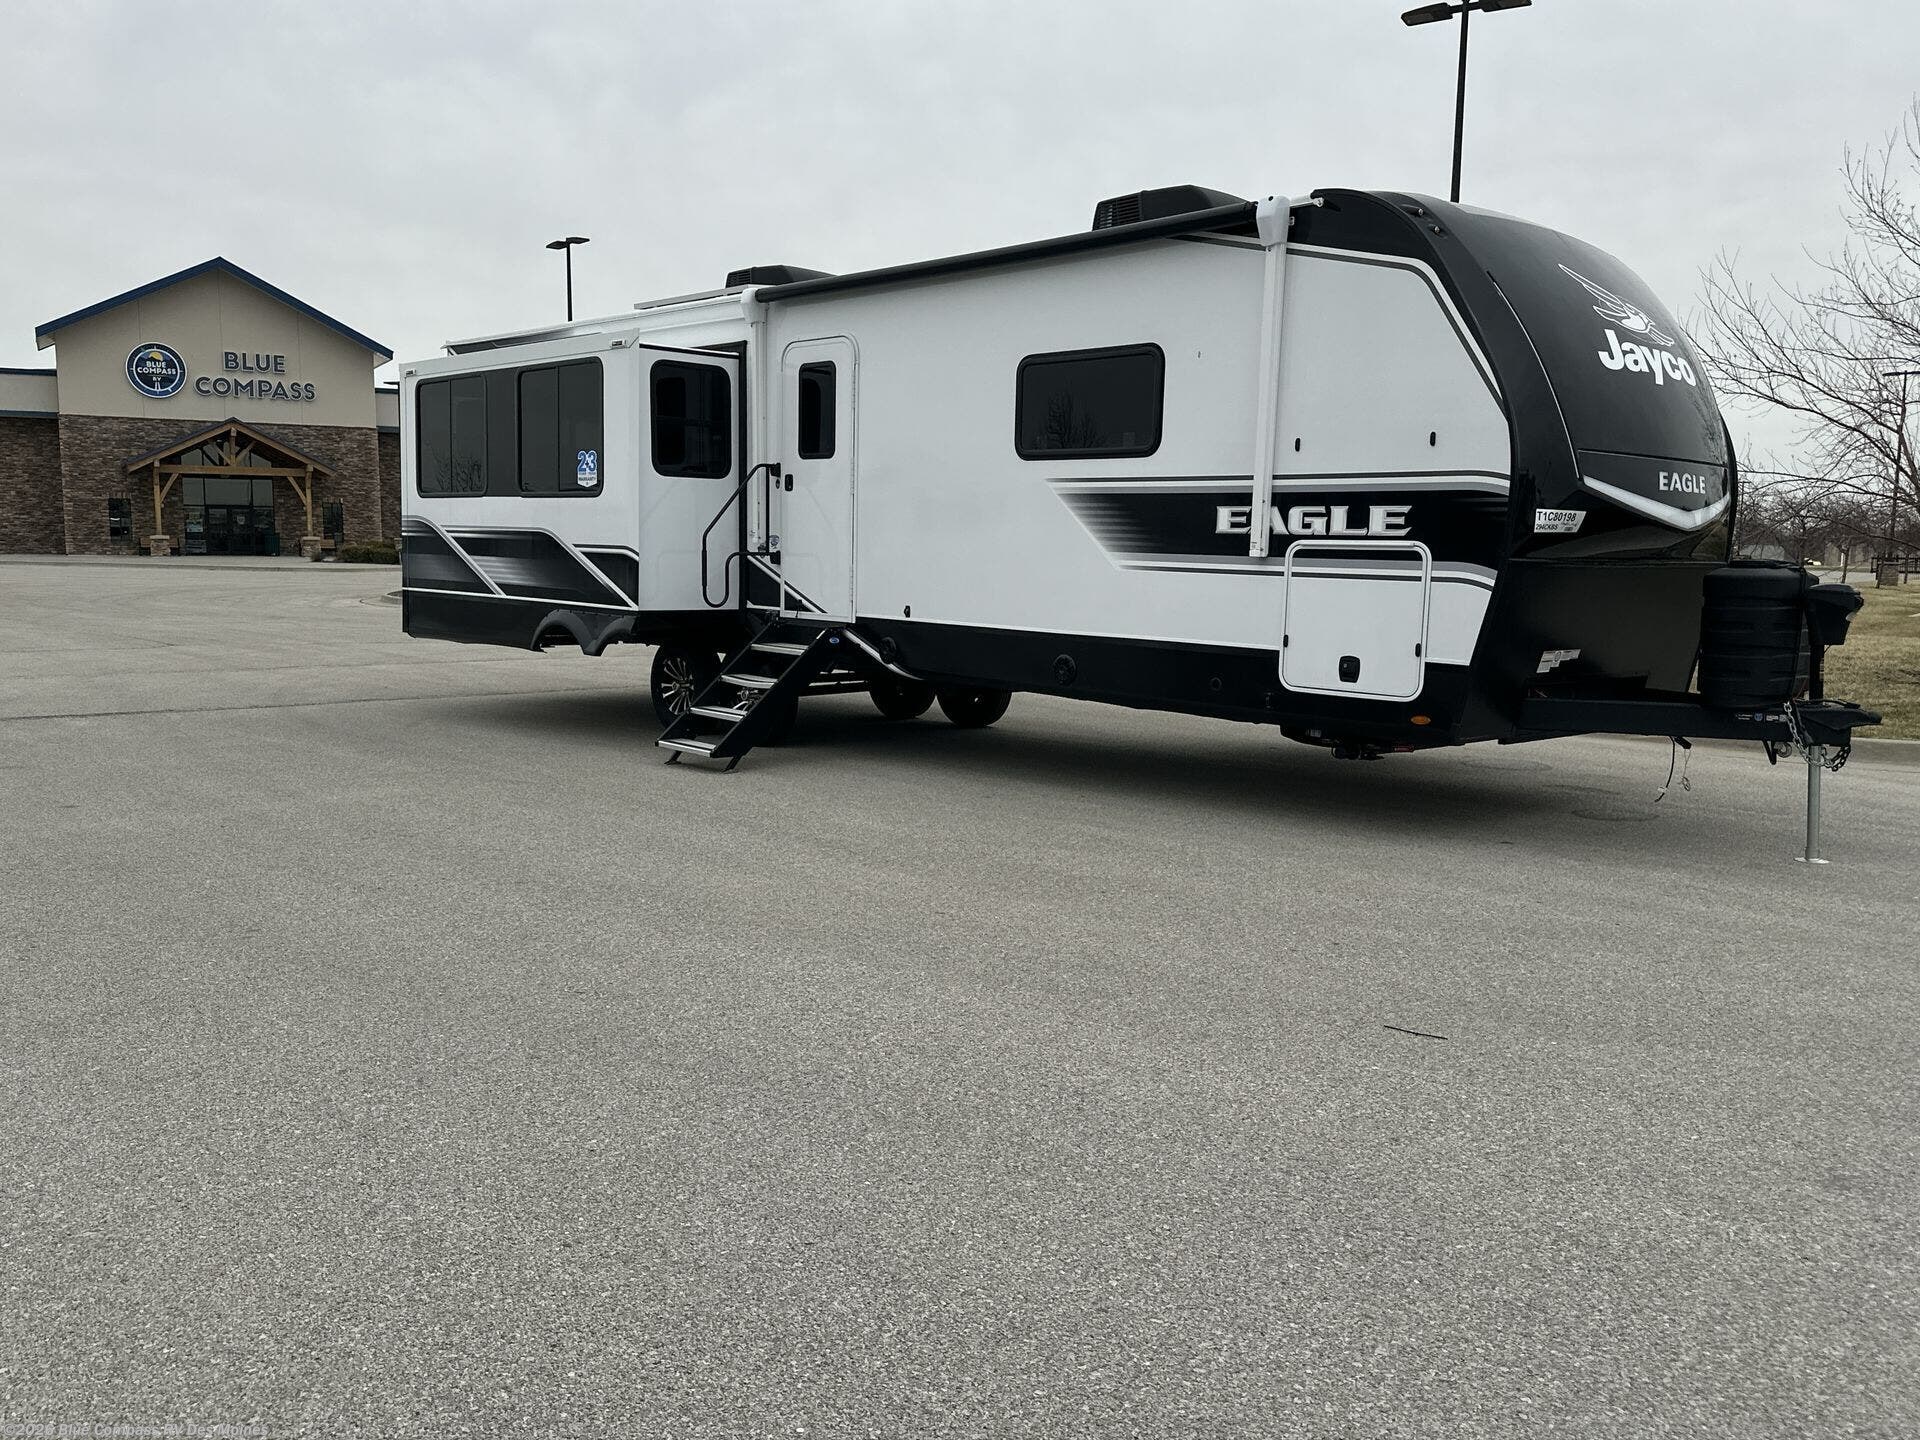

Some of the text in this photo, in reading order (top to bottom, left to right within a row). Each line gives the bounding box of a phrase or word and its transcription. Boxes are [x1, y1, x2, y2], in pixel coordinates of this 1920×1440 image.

[223, 351, 286, 374] BLUE
[1598, 328, 1698, 387] Jayco
[137, 367, 177, 375] COMPASS
[194, 376, 316, 401] COMPASS
[1658, 470, 1706, 495] EAGLE
[1536, 511, 1577, 522] T1C80198
